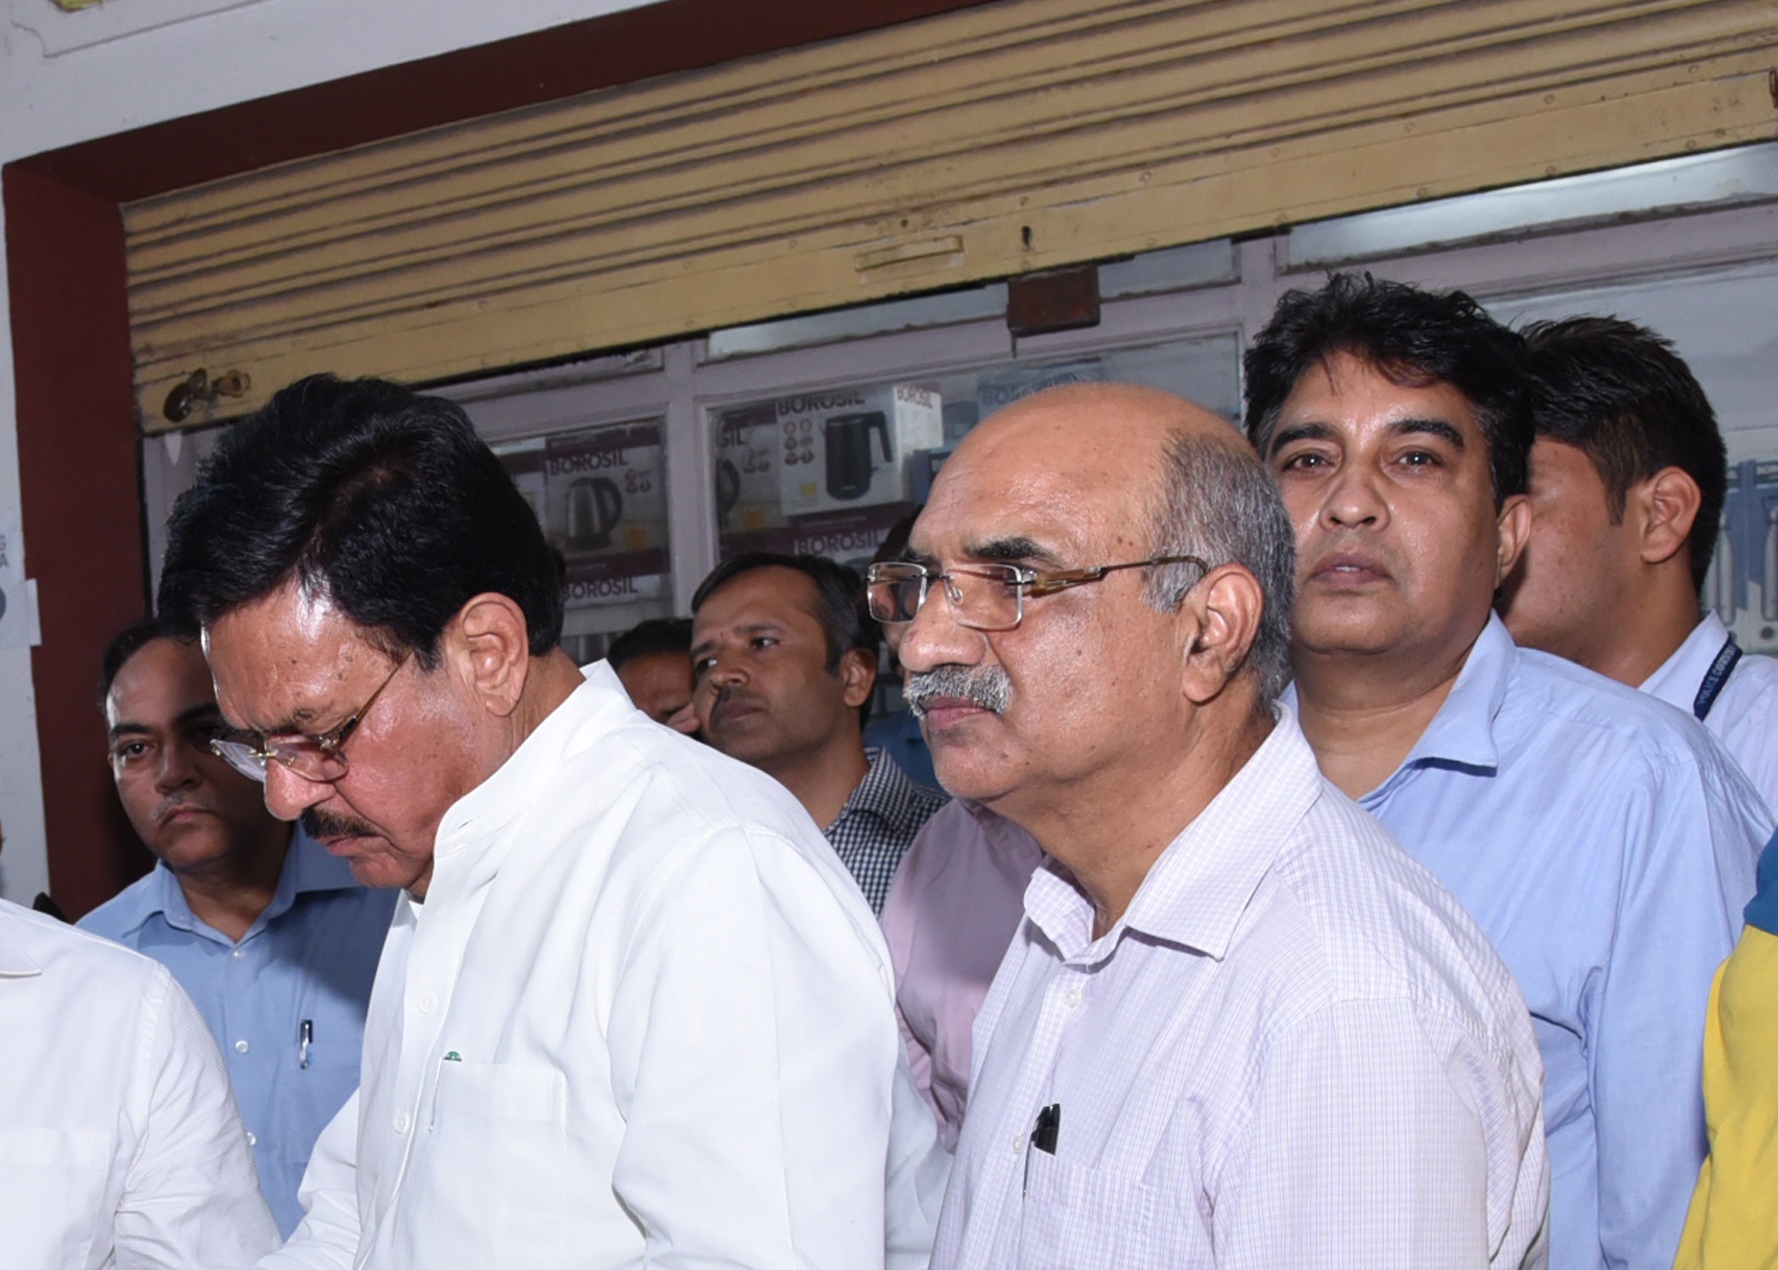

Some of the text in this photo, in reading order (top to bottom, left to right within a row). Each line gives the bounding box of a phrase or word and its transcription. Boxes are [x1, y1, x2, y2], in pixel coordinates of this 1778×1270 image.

[778, 392, 866, 416] BOROSIL
[548, 450, 629, 476] BOROSIL
[795, 531, 880, 555] BOROSIL
